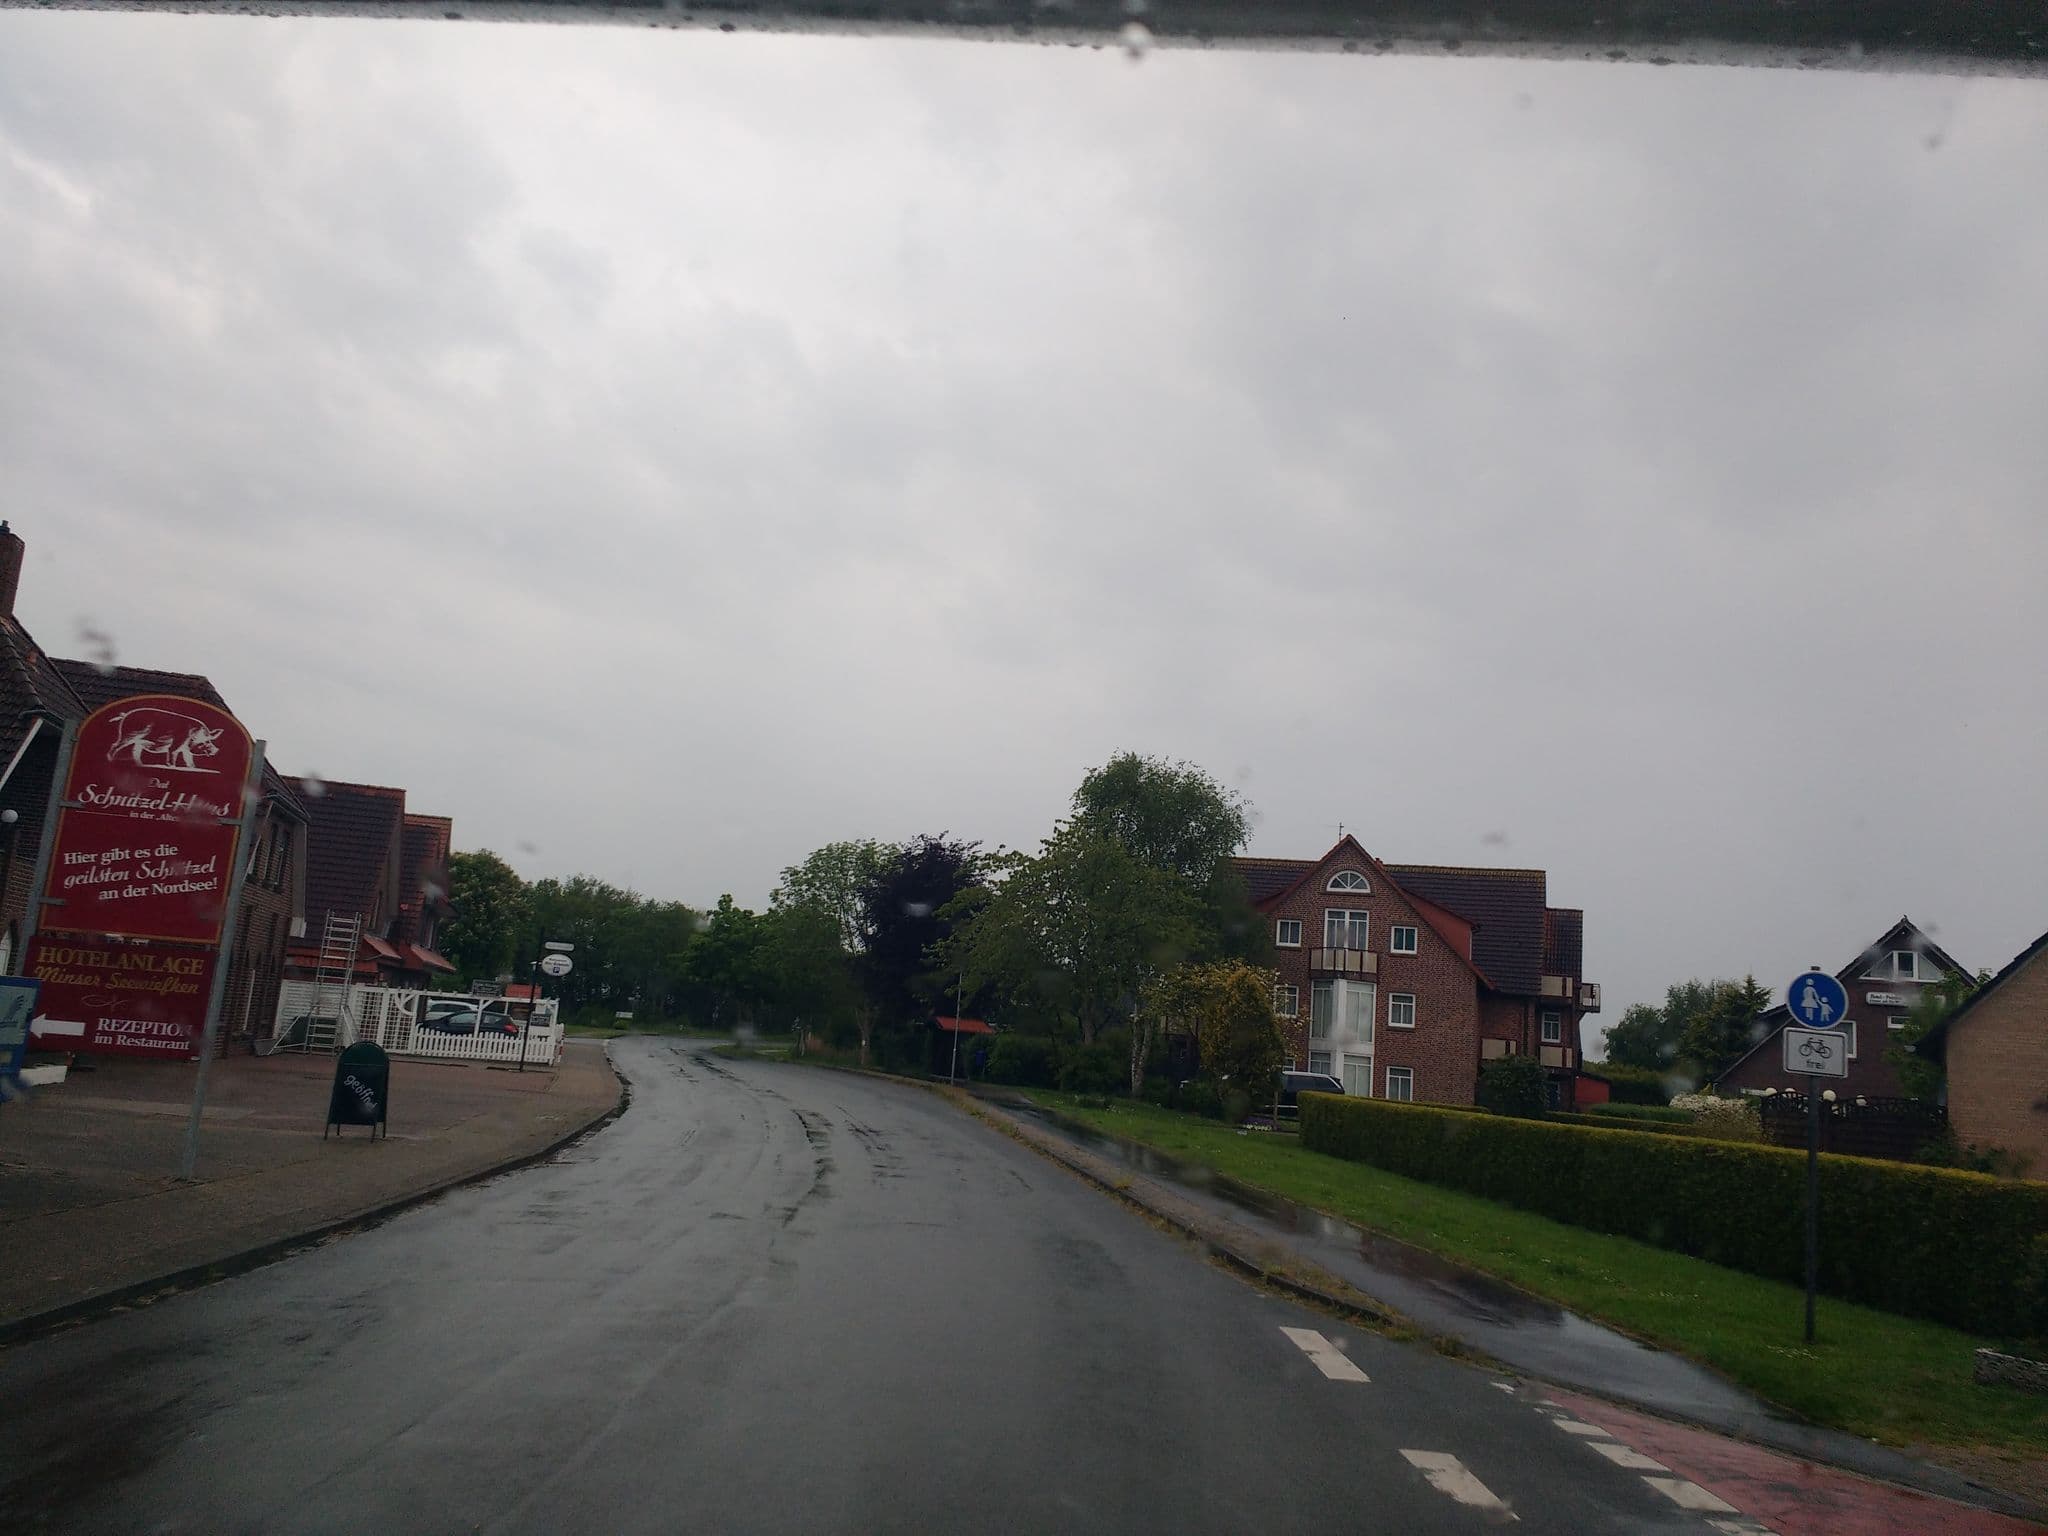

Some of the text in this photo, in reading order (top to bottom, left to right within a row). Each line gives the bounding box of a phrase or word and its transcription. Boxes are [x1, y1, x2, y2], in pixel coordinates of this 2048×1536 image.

[78, 783, 230, 816] Schnitzel-Hus
[140, 812, 155, 820] der
[64, 844, 178, 865] Hier gibt es die
[64, 866, 129, 888] geilsten
[98, 877, 218, 900] an der Nordsee!
[37, 946, 205, 975] HOTELANLAGE
[33, 966, 100, 986] Minser
[95, 1033, 190, 1050] im Restaurant
